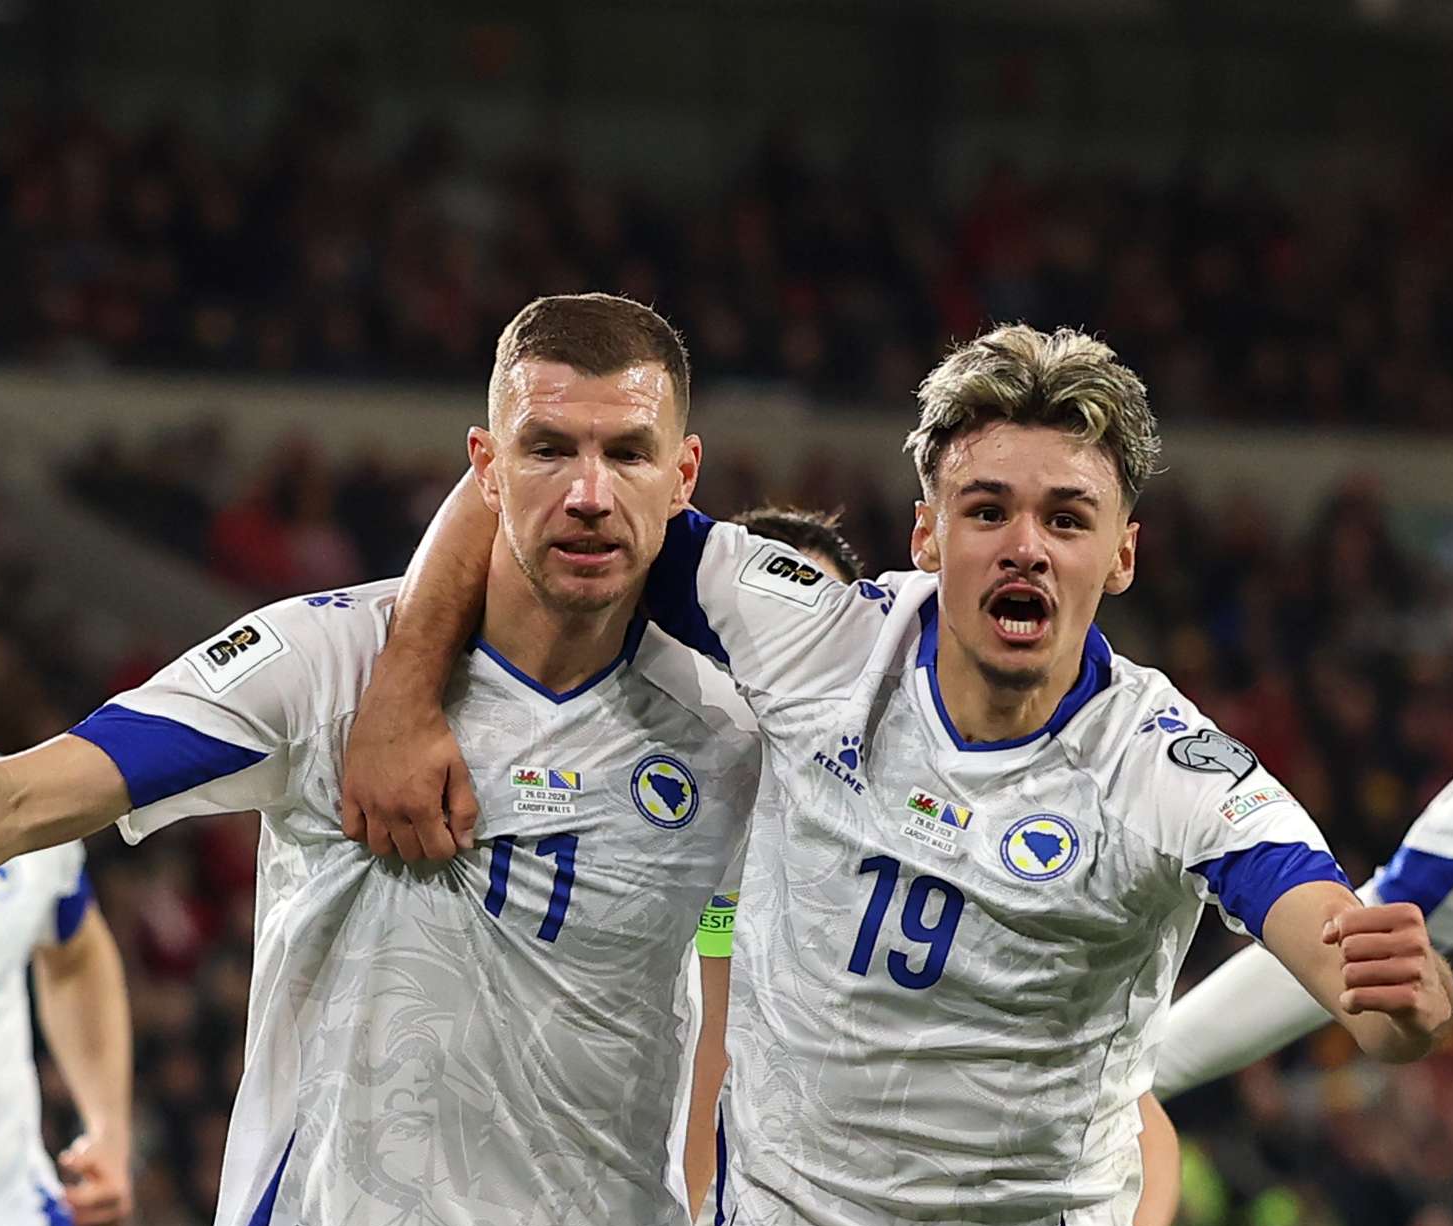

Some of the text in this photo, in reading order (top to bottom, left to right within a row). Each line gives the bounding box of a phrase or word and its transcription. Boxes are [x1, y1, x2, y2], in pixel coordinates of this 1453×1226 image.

[813, 751, 866, 796] KELME
[484, 833, 579, 943] 11
[847, 855, 966, 990] 19
